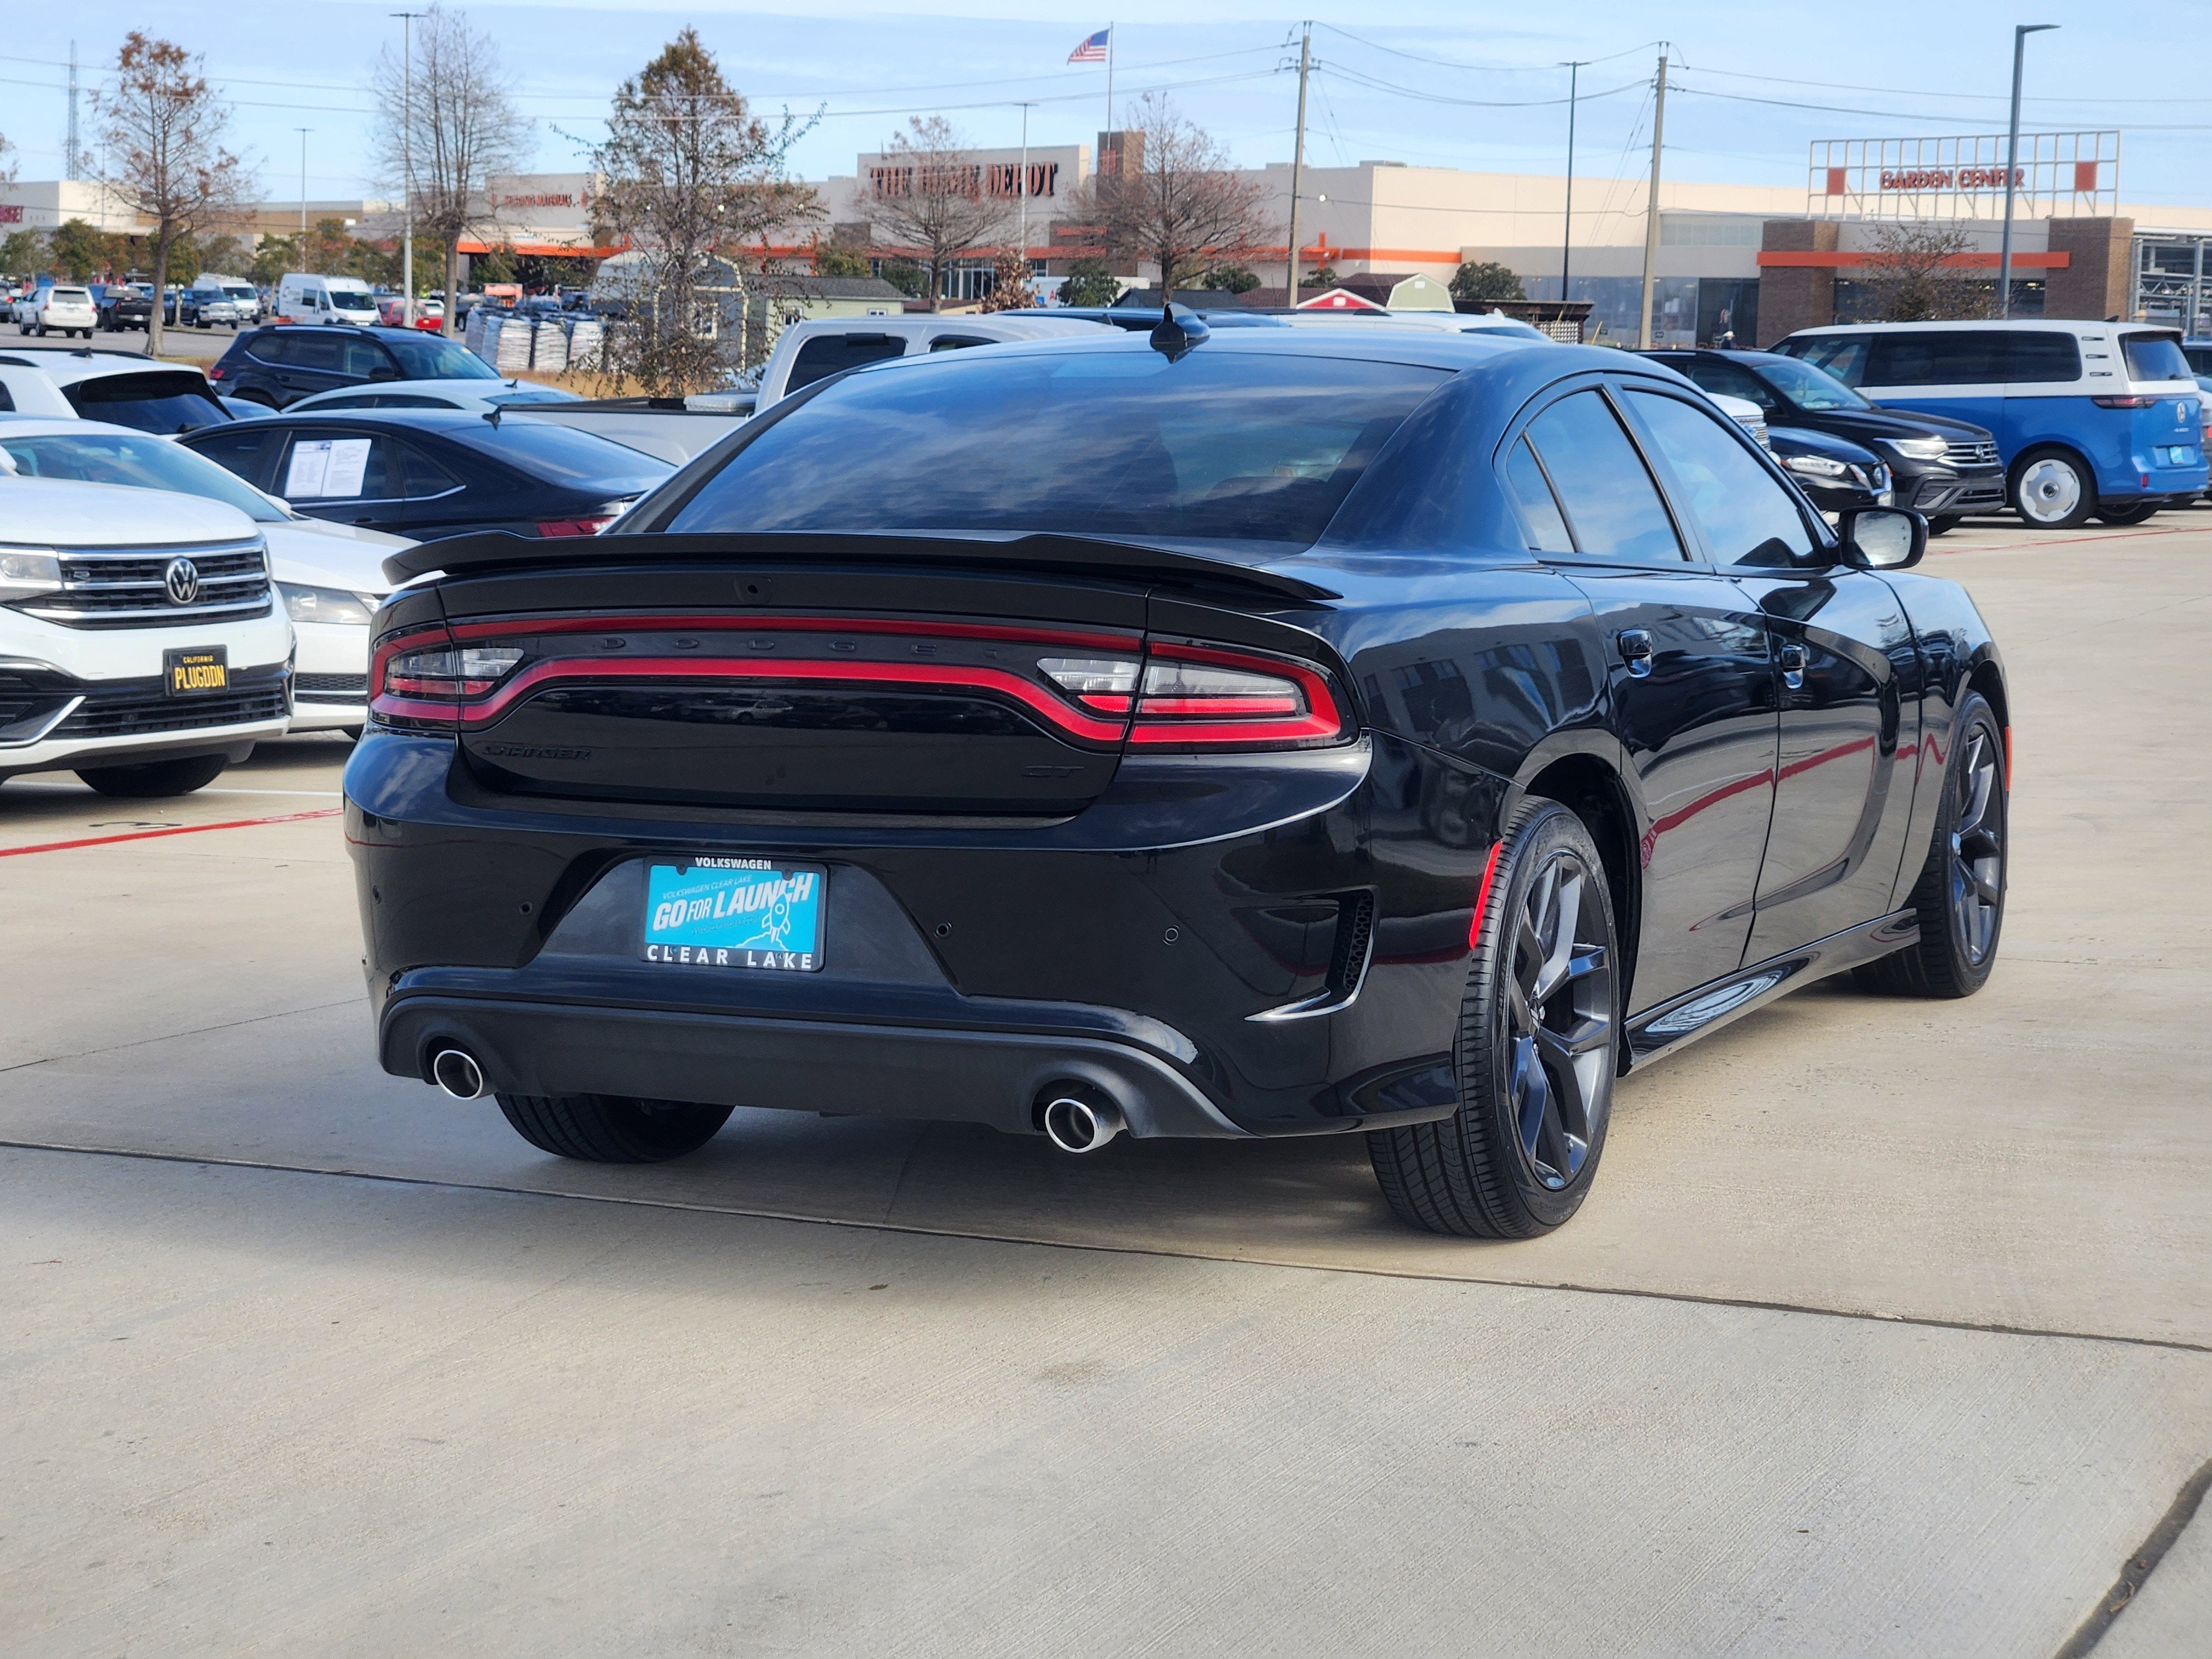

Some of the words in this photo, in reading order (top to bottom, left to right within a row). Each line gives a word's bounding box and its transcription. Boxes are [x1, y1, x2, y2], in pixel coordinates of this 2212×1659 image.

[1880, 169, 1954, 189] GARDEN
[695, 857, 771, 870] VOLKSWAGEN
[662, 883, 710, 899] VOLKSWAGEN
[711, 878, 733, 890] CLEAR
[734, 875, 753, 885] LAKE
[653, 899, 687, 931] GO
[686, 897, 713, 922] FOR
[713, 873, 814, 919] LAUNCH
[646, 945, 728, 965] CLEAR
[747, 950, 812, 969] LAKE
